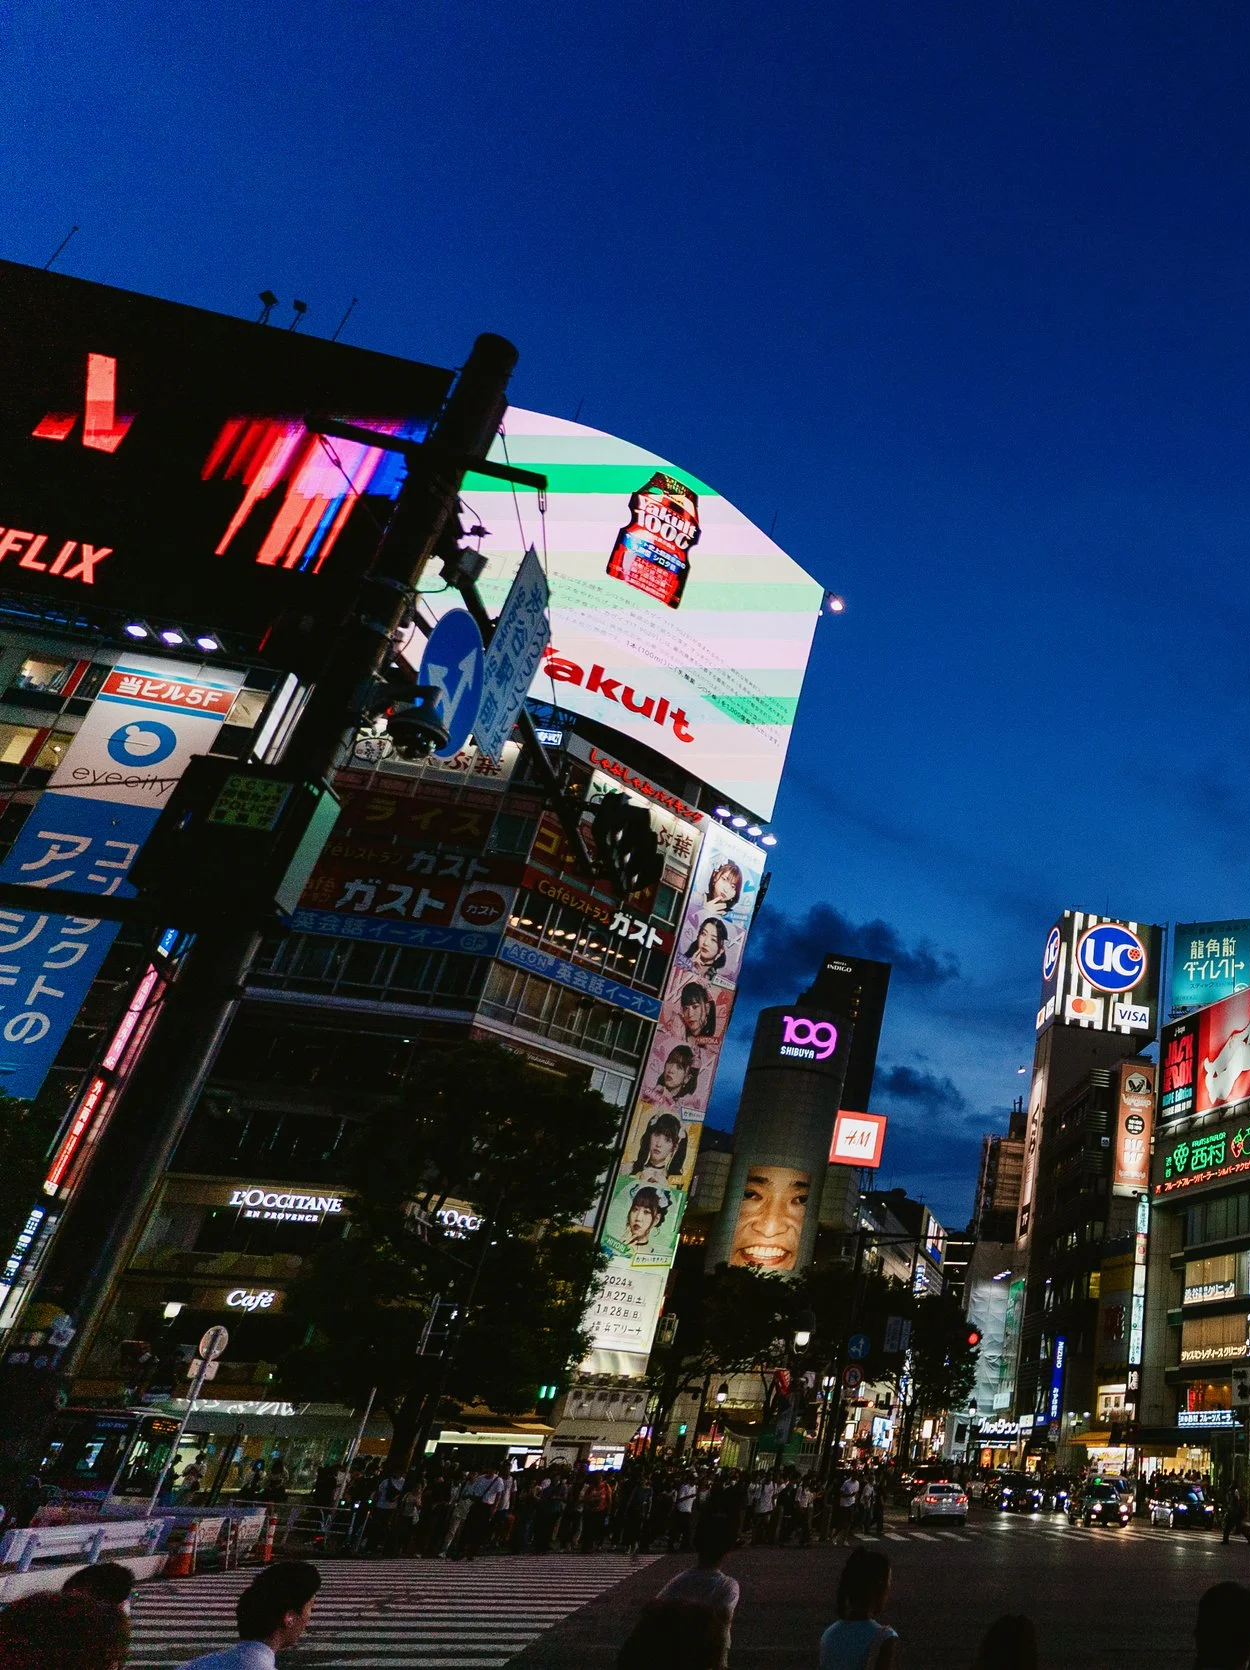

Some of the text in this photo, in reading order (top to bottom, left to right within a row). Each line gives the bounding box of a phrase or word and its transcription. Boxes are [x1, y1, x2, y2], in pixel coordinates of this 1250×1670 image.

[638, 494, 697, 539] Yakult
[116, 675, 223, 707] 当ビル5F
[406, 850, 490, 880] ガスト
[334, 877, 446, 919] ガスト
[291, 911, 453, 946] 英会話イーオン
[609, 911, 664, 949] ガスト
[1085, 938, 1140, 977] UC
[1190, 936, 1236, 960] 龍角散
[827, 964, 852, 973] INDIGO
[1182, 958, 1245, 981] ダイレクト
[554, 964, 660, 1015] 英会話イーオン
[1119, 1009, 1148, 1023] VISA
[780, 1046, 815, 1059] SHIBUYA
[783, 1015, 838, 1060] 109
[1191, 1140, 1226, 1171] 西村
[229, 1189, 343, 1213] L'OCCITANE
[246, 1210, 318, 1223] EN PROVENCE
[226, 1289, 277, 1311] Café
[1055, 1341, 1065, 1369] MIZUHO
